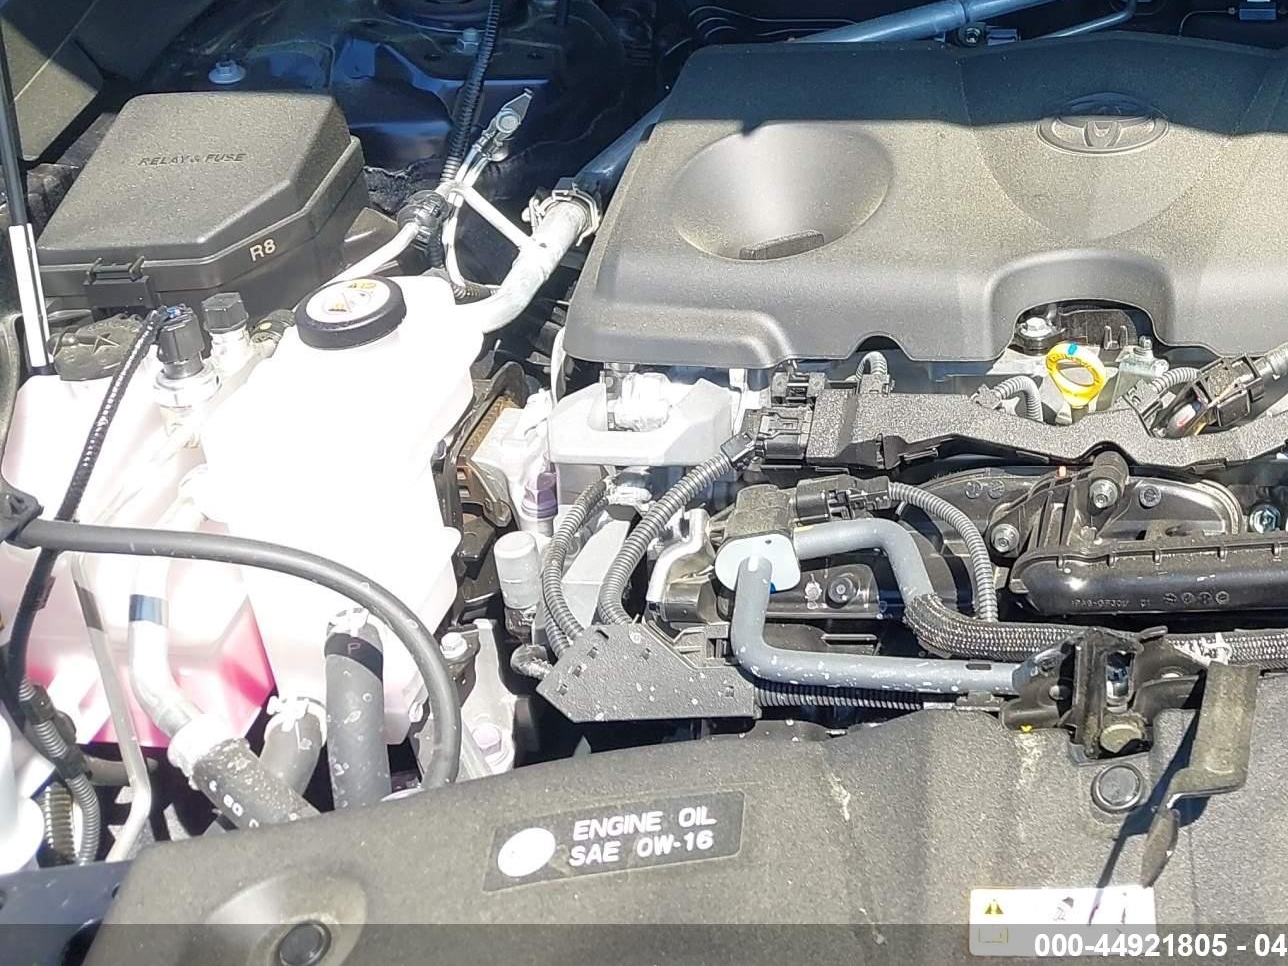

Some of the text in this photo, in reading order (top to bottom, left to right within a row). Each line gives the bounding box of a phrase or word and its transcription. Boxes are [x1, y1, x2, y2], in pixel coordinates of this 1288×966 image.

[203, 152, 247, 163] FUSE
[249, 238, 277, 262] R8
[572, 805, 718, 842] ENGINE OIL
[568, 829, 714, 867] SAE 0W-16
